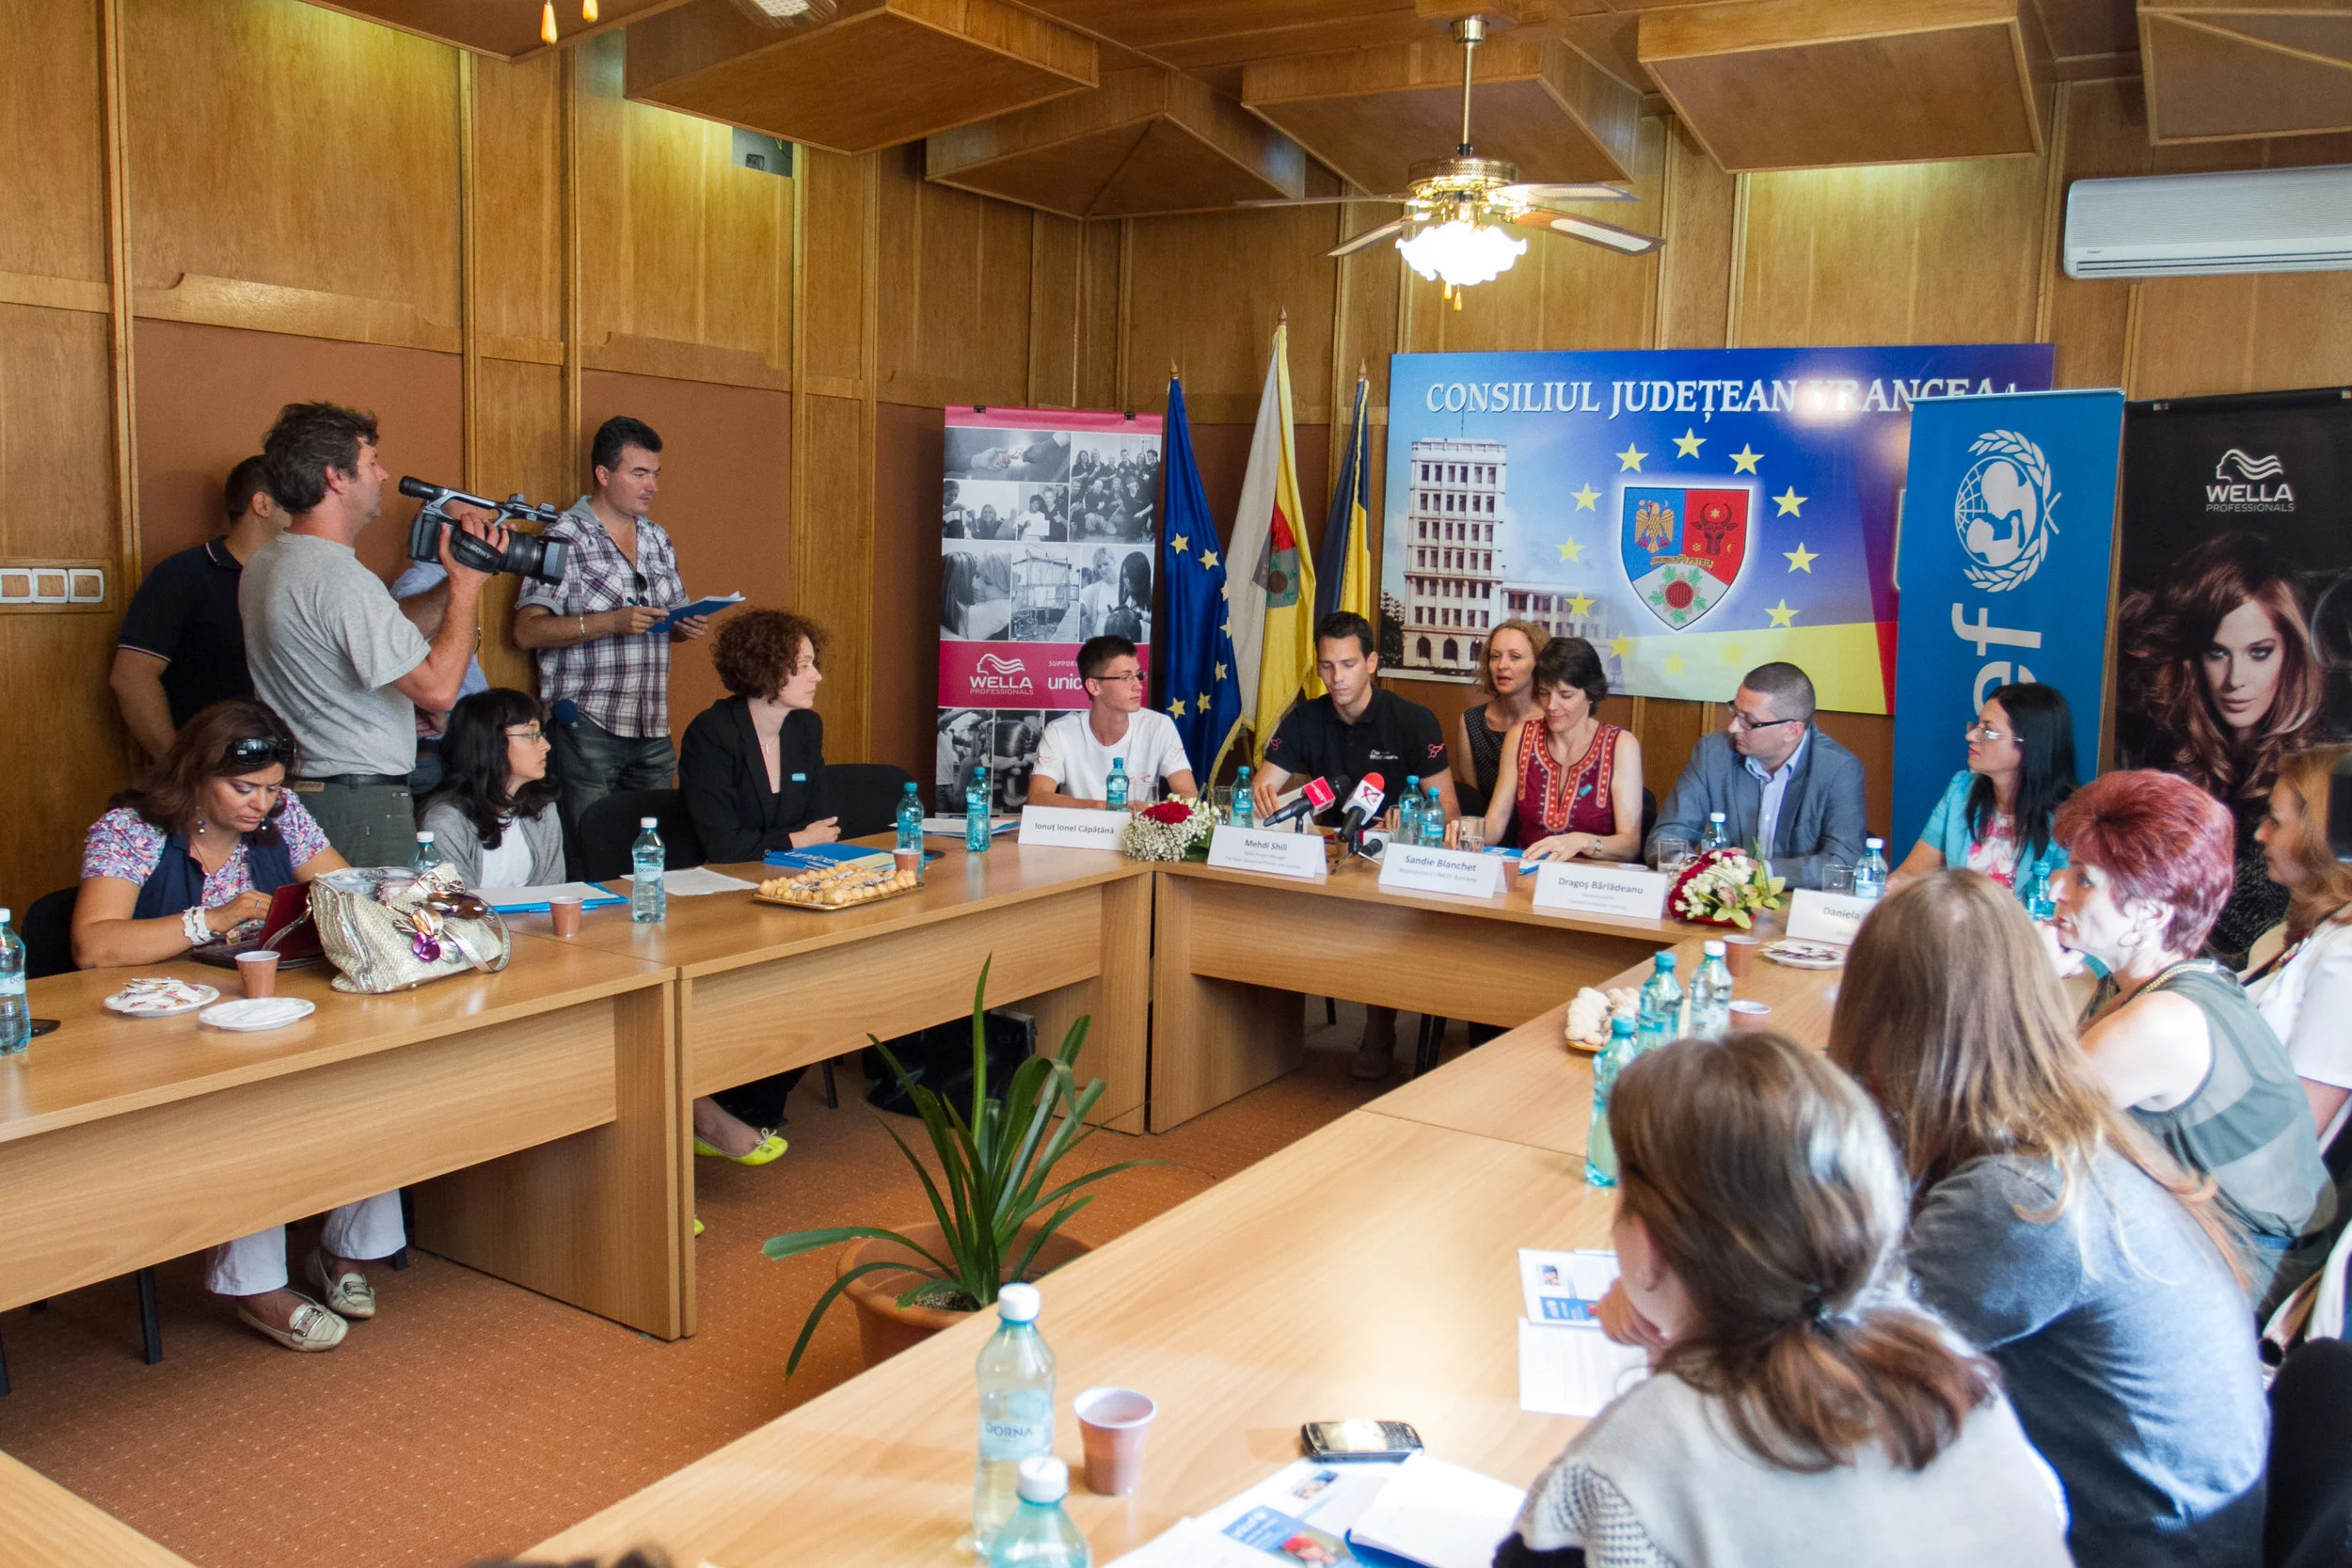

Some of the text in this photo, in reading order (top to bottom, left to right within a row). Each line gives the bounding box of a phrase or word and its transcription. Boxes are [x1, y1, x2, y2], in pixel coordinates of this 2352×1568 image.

[1426, 381, 1600, 412] CONSILIUL
[1608, 378, 1796, 423] JUDEȚEAN
[2205, 483, 2294, 502] WELLA
[2205, 503, 2295, 513] PROFESSIONALS
[969, 675, 1033, 689] WELLA
[1047, 673, 1083, 690] unic
[1057, 824, 1076, 832] Ionel
[1244, 839, 1288, 851] Mehdi Shili
[1405, 855, 1476, 872] Sandie Blanchet
[1822, 907, 1861, 920] Daniela
[985, 1421, 1034, 1439] DORNA
